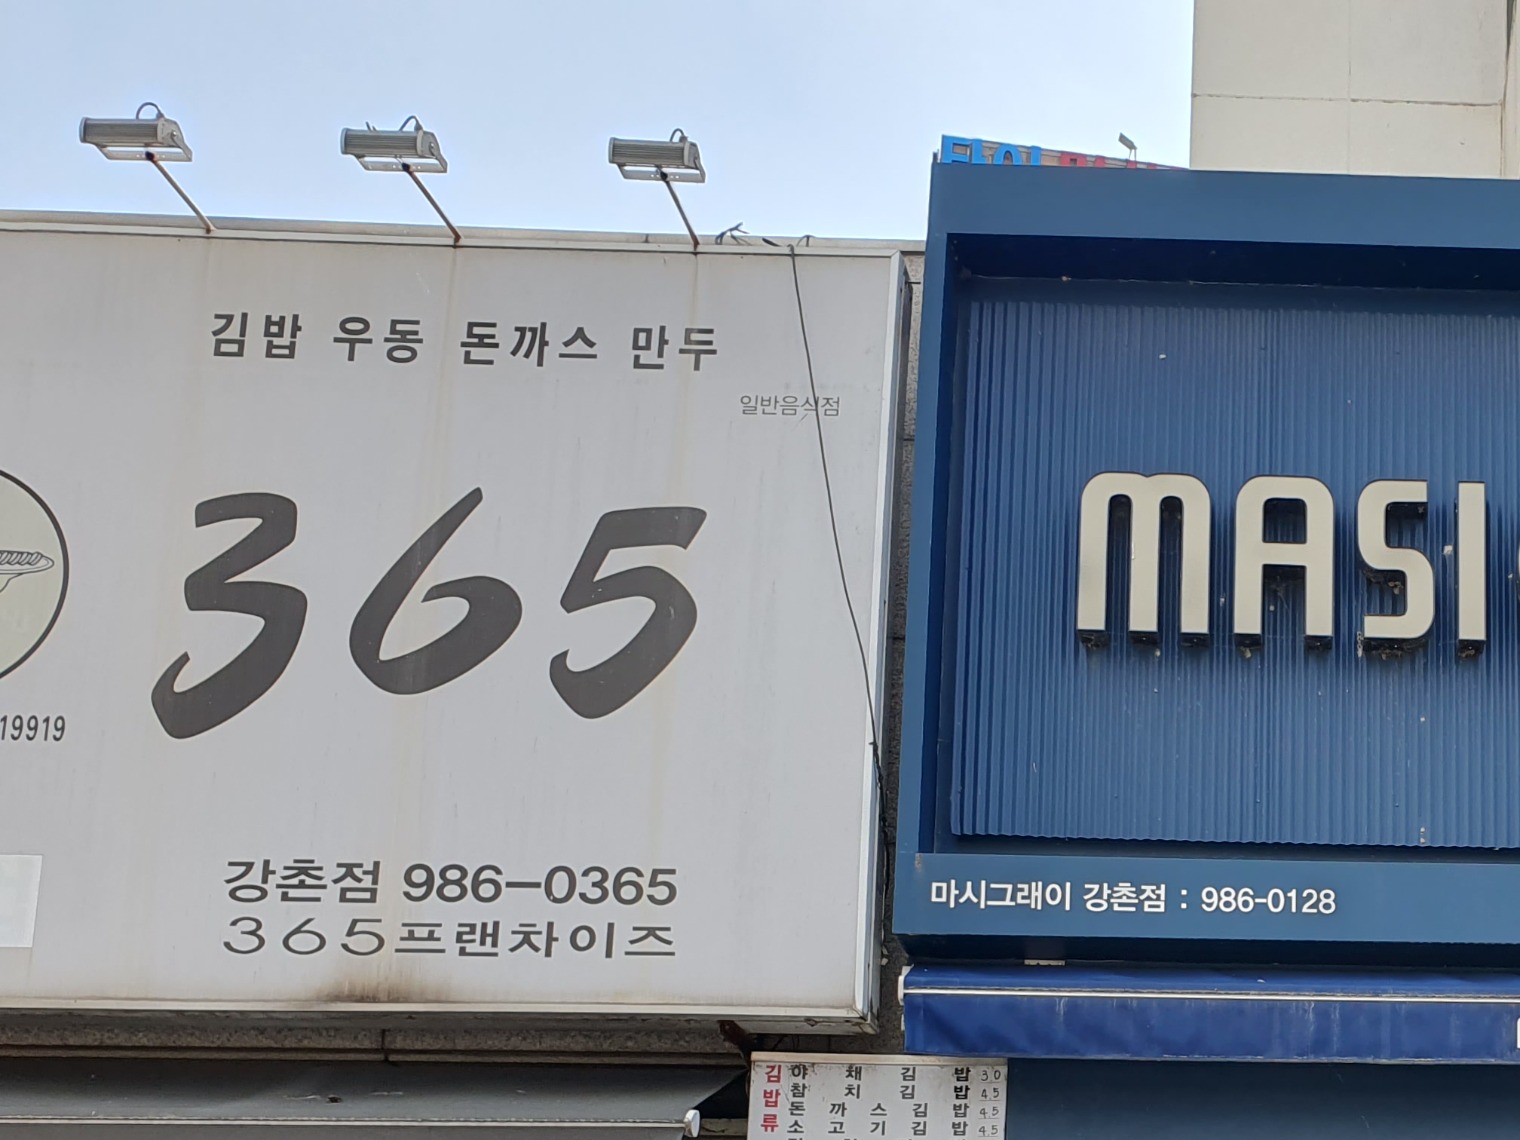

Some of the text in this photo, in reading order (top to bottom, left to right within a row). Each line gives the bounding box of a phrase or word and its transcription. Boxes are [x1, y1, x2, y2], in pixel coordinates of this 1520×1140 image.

[210, 311, 719, 371] 김밥 우동 돈까스 만두
[739, 394, 841, 417] 일반음식점
[1077, 471, 1486, 648] MASI
[151, 486, 708, 739] 365
[221, 858, 678, 907] 강촌점 986-0365
[930, 878, 1337, 915] 마시그래이 강촌점 986-0128
[761, 1064, 783, 1132] 김밥류
